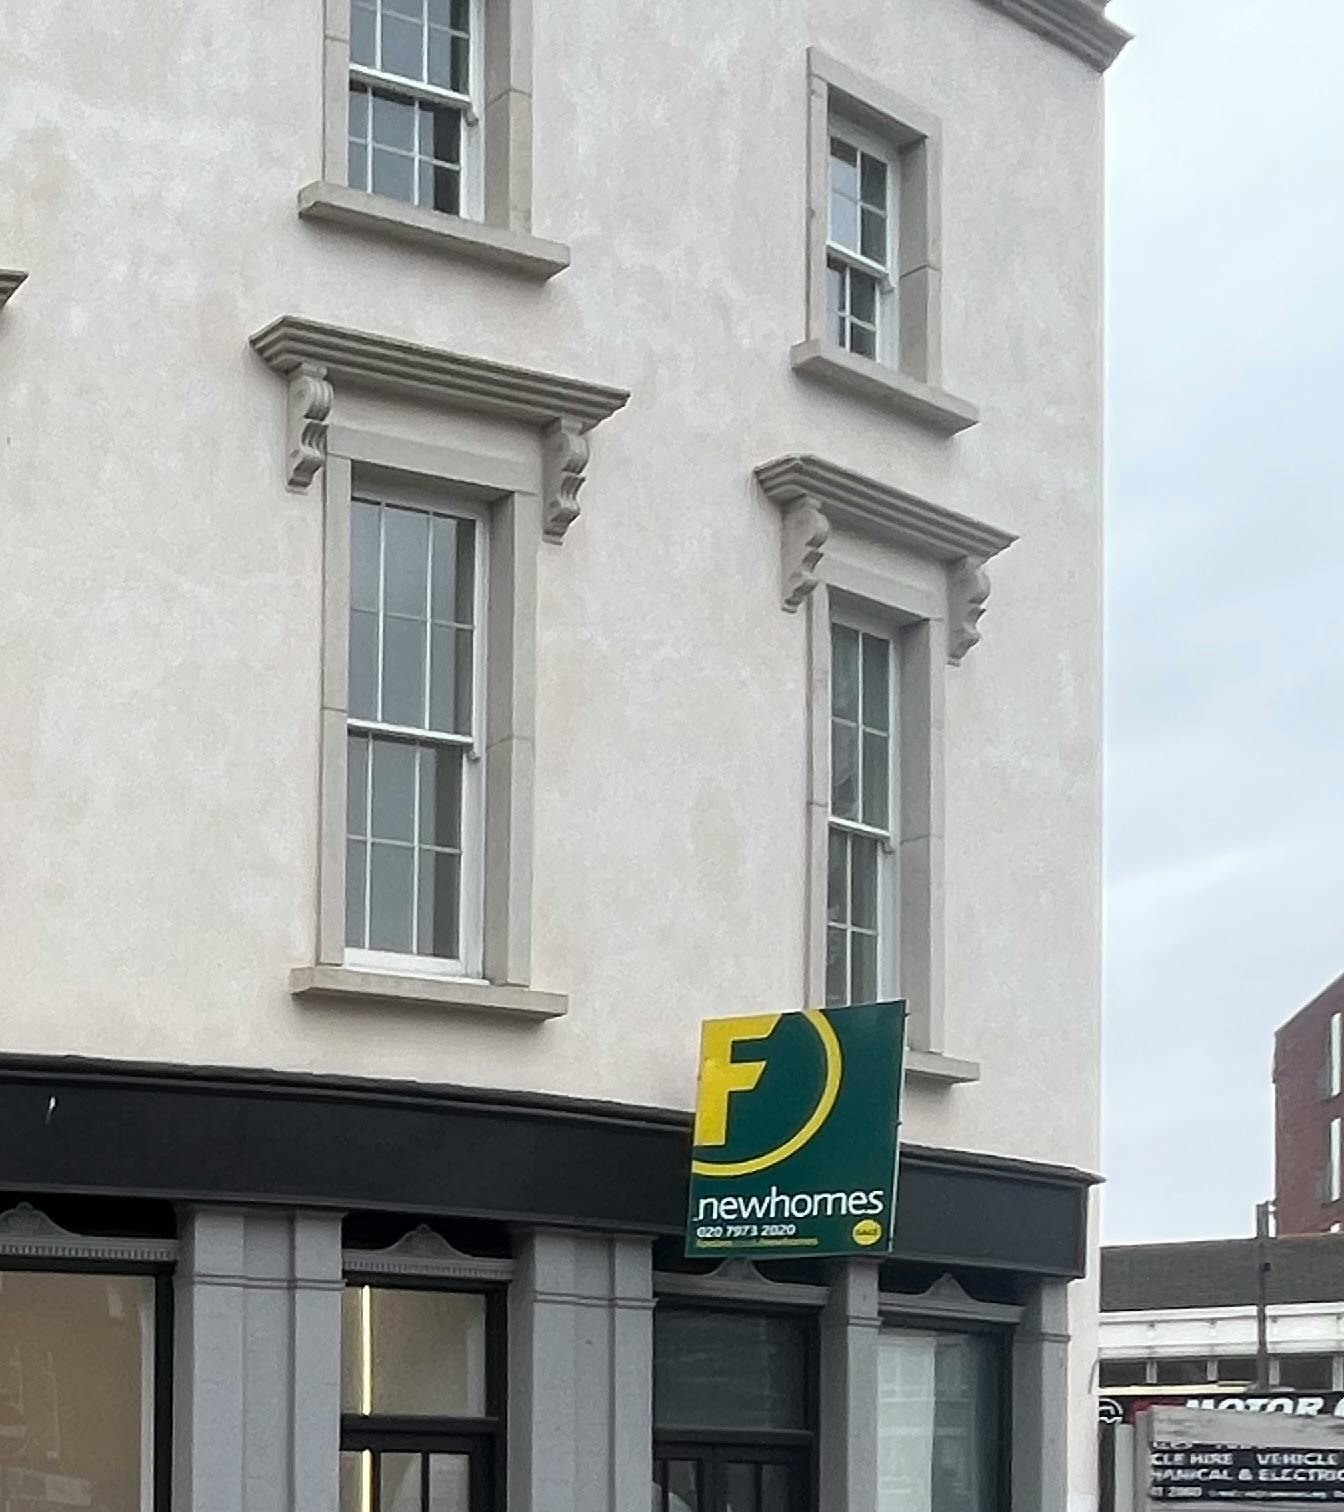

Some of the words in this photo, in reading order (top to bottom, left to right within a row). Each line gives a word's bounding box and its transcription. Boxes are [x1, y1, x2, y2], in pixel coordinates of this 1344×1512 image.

[696, 1226, 723, 1238] 020
[761, 1224, 796, 1236] 2020
[1190, 1453, 1234, 1466] HIRE
[1257, 1452, 1339, 1466] VEHICLE
